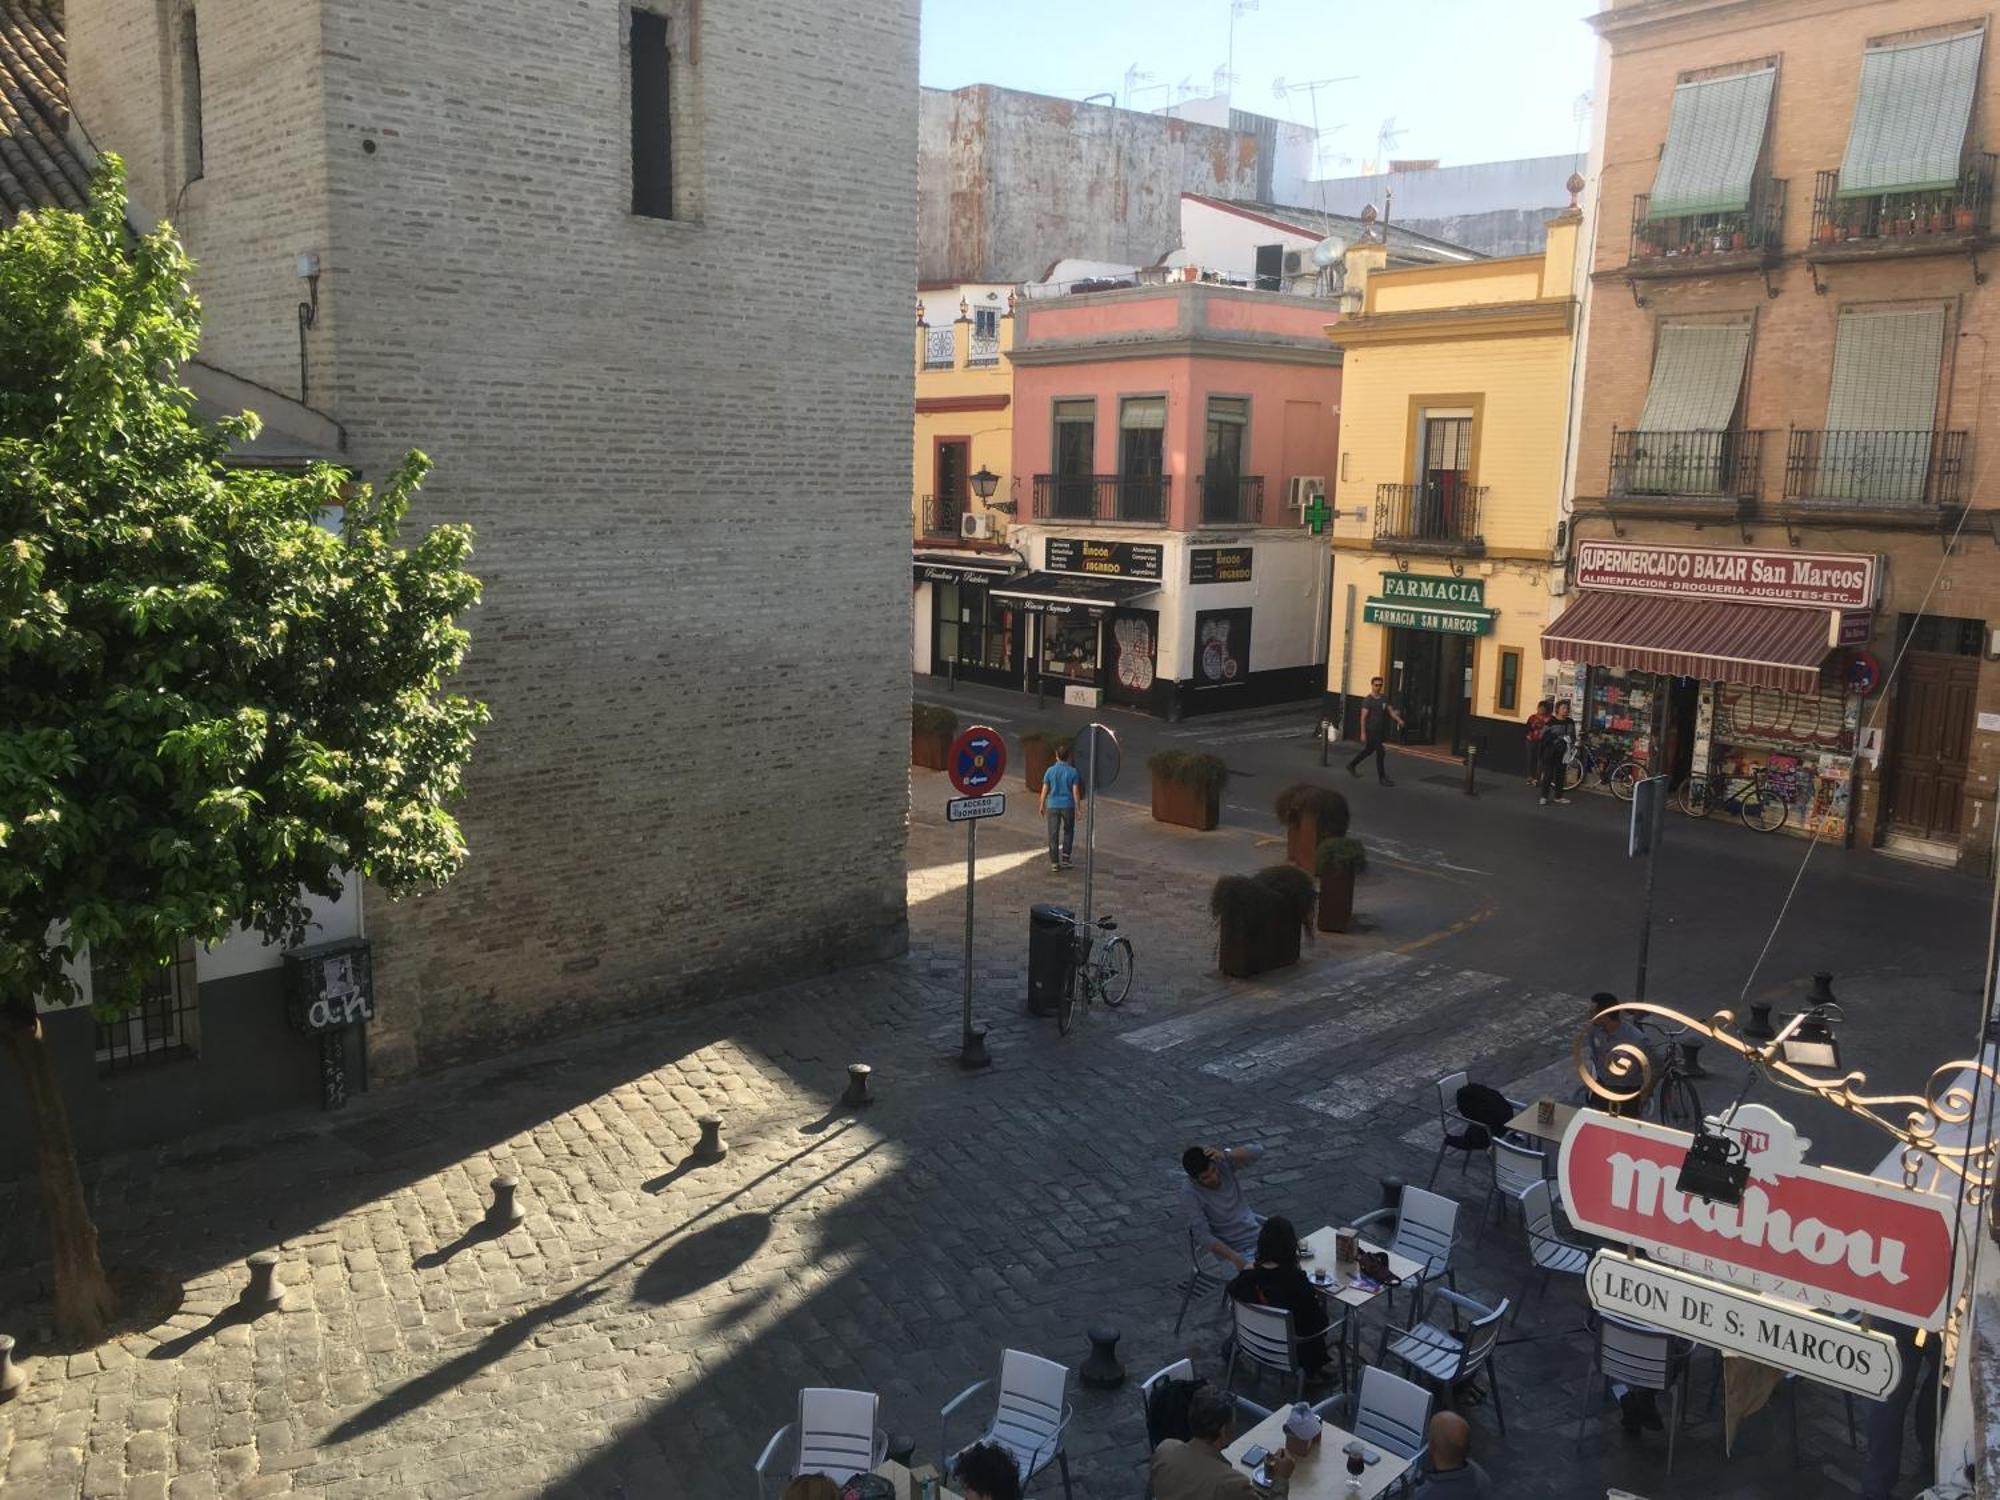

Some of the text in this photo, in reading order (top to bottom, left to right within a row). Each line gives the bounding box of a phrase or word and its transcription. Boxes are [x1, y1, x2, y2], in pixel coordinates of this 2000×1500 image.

[1581, 548, 1864, 589] SUPERMERCADO BAZAR San Marcos
[1386, 579, 1480, 601] FARMACIA
[1583, 574, 1667, 588] ALIMENTACION
[1373, 609, 1478, 632] FARMACIA SAN MARCOS
[963, 799, 992, 808] ACCESO
[1656, 1245, 1834, 1307] CERVEZAS
[1604, 1272, 1670, 1313] LEON
[1681, 1295, 1714, 1327] DE
[1757, 1319, 1872, 1376] MARCOS
